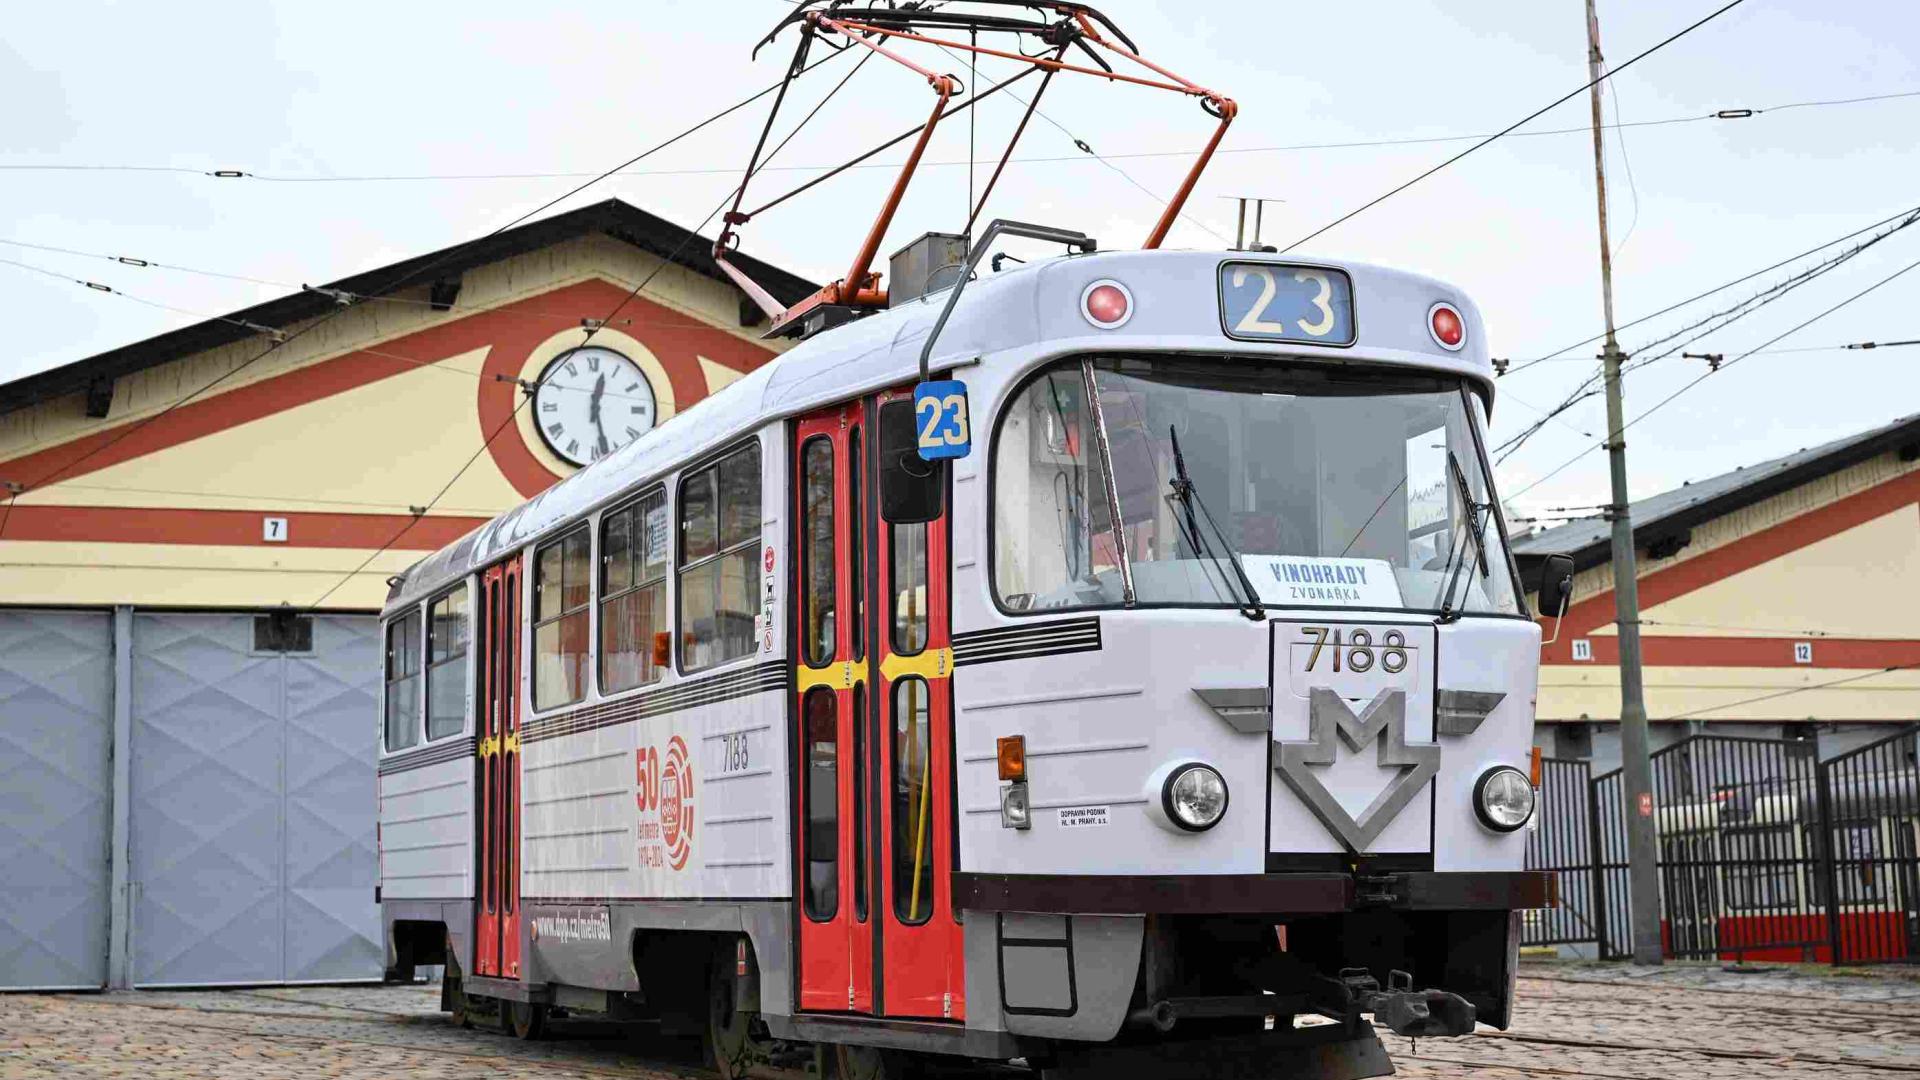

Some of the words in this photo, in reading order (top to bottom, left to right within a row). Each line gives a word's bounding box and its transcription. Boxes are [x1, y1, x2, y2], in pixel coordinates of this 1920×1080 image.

[1233, 266, 1334, 336] 23
[916, 394, 969, 448] 23
[270, 521, 279, 537] 7
[1270, 563, 1367, 585] VINOHRADY
[1301, 626, 1408, 673] 7188
[1576, 643, 1588, 656] 11
[1797, 645, 1809, 659] 12
[723, 733, 749, 773] 7188
[636, 745, 659, 812] 50
[1086, 808, 1106, 816] PODNIK
